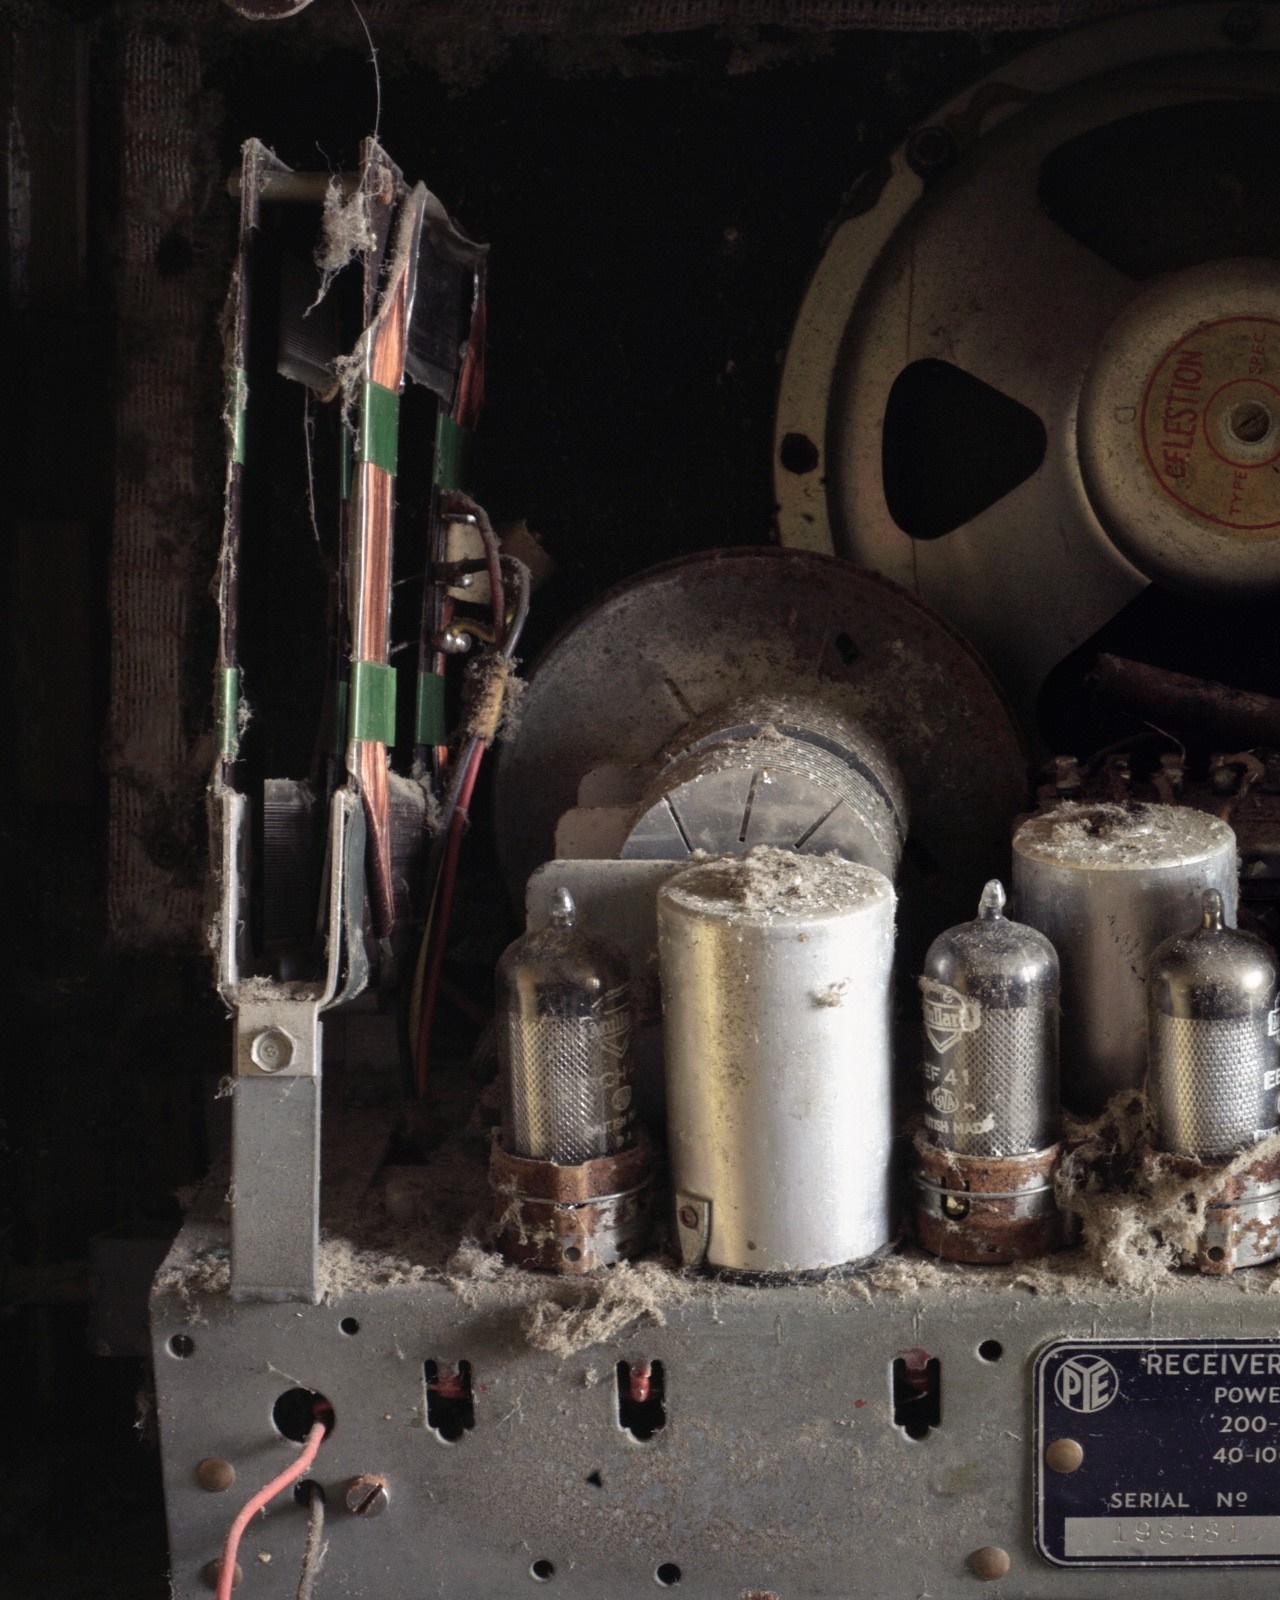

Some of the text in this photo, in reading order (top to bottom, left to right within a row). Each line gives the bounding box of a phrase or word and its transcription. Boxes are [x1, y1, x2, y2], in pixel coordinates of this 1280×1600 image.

[1248, 332, 1266, 376] SPEC
[1228, 470, 1248, 516] TYPE
[1060, 1356, 1112, 1412] PYE
[1111, 1492, 1190, 1509] SERIAL
